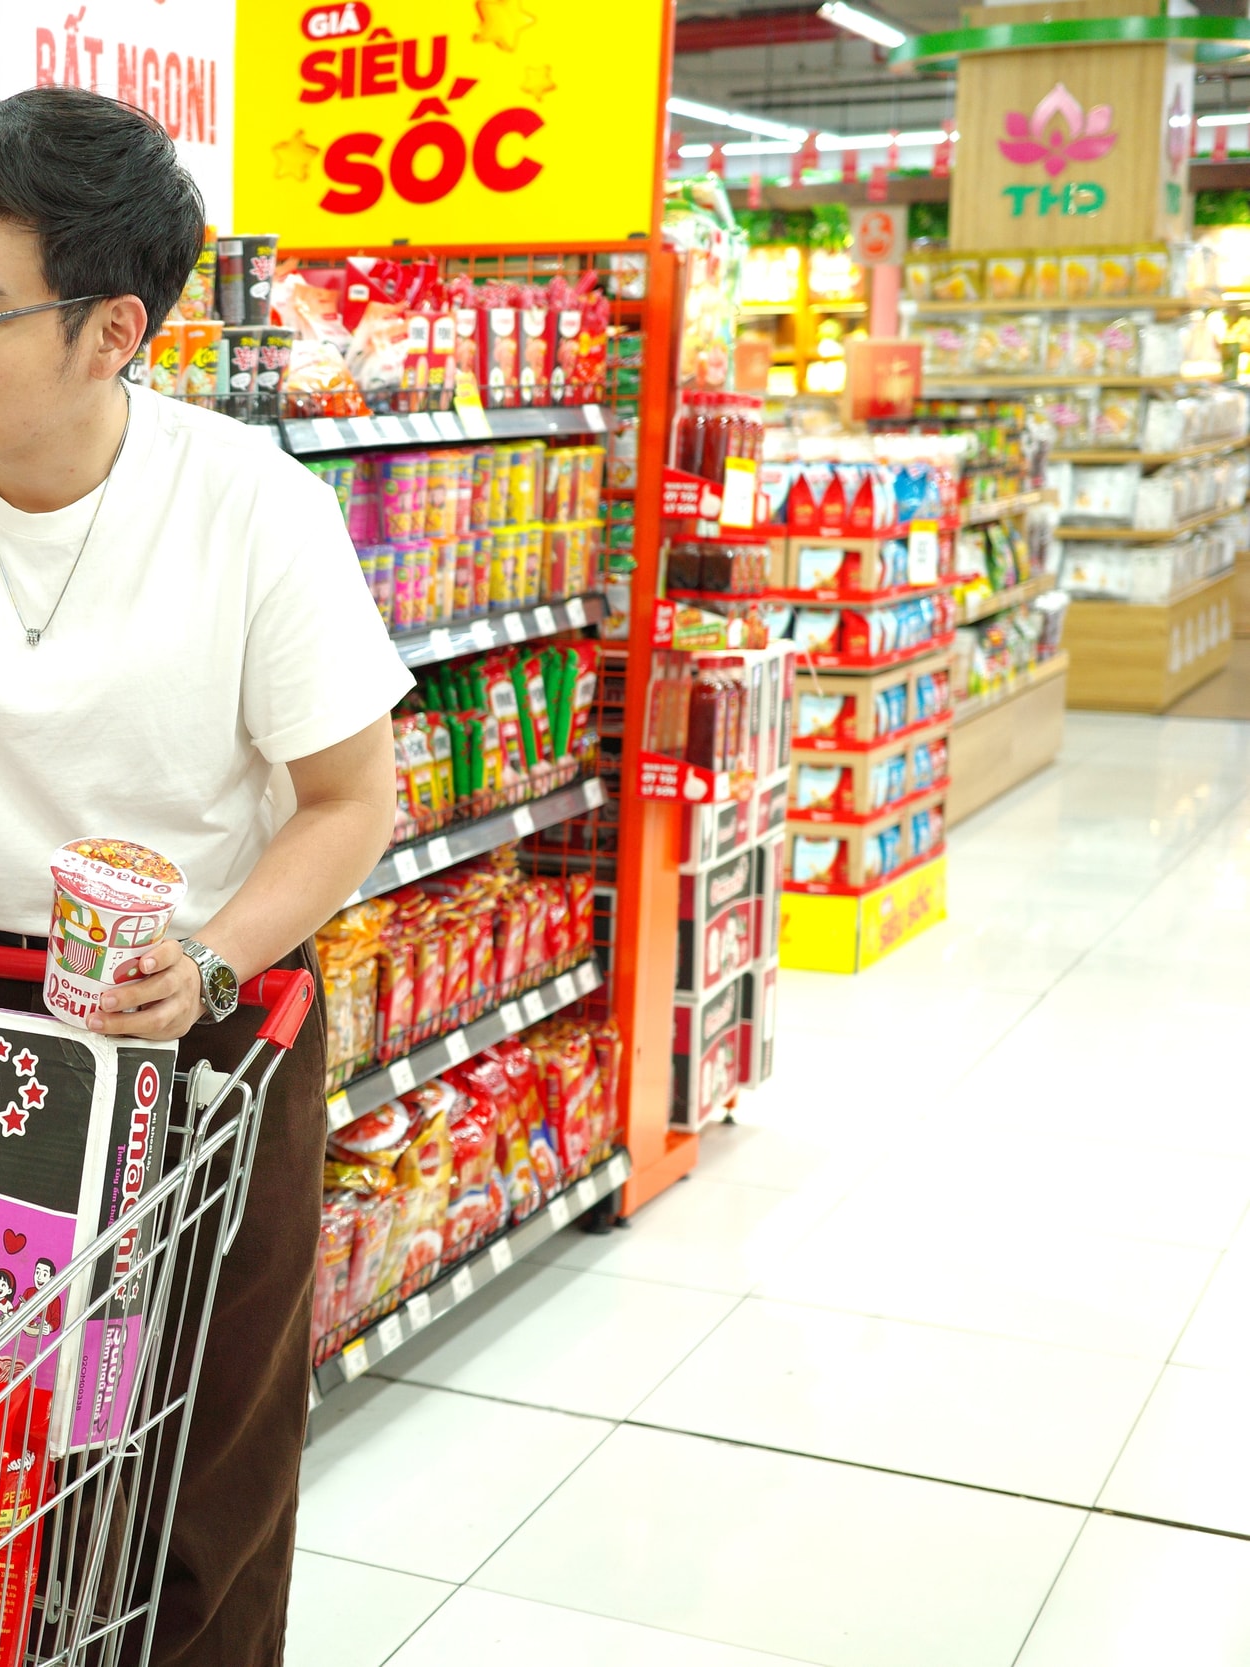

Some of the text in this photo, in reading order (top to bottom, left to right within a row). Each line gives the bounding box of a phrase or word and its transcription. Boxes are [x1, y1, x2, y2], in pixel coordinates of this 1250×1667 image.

[307, 3, 361, 38] GIÁ
[298, 27, 449, 104] SIÊU
[318, 77, 546, 215] SỐC
